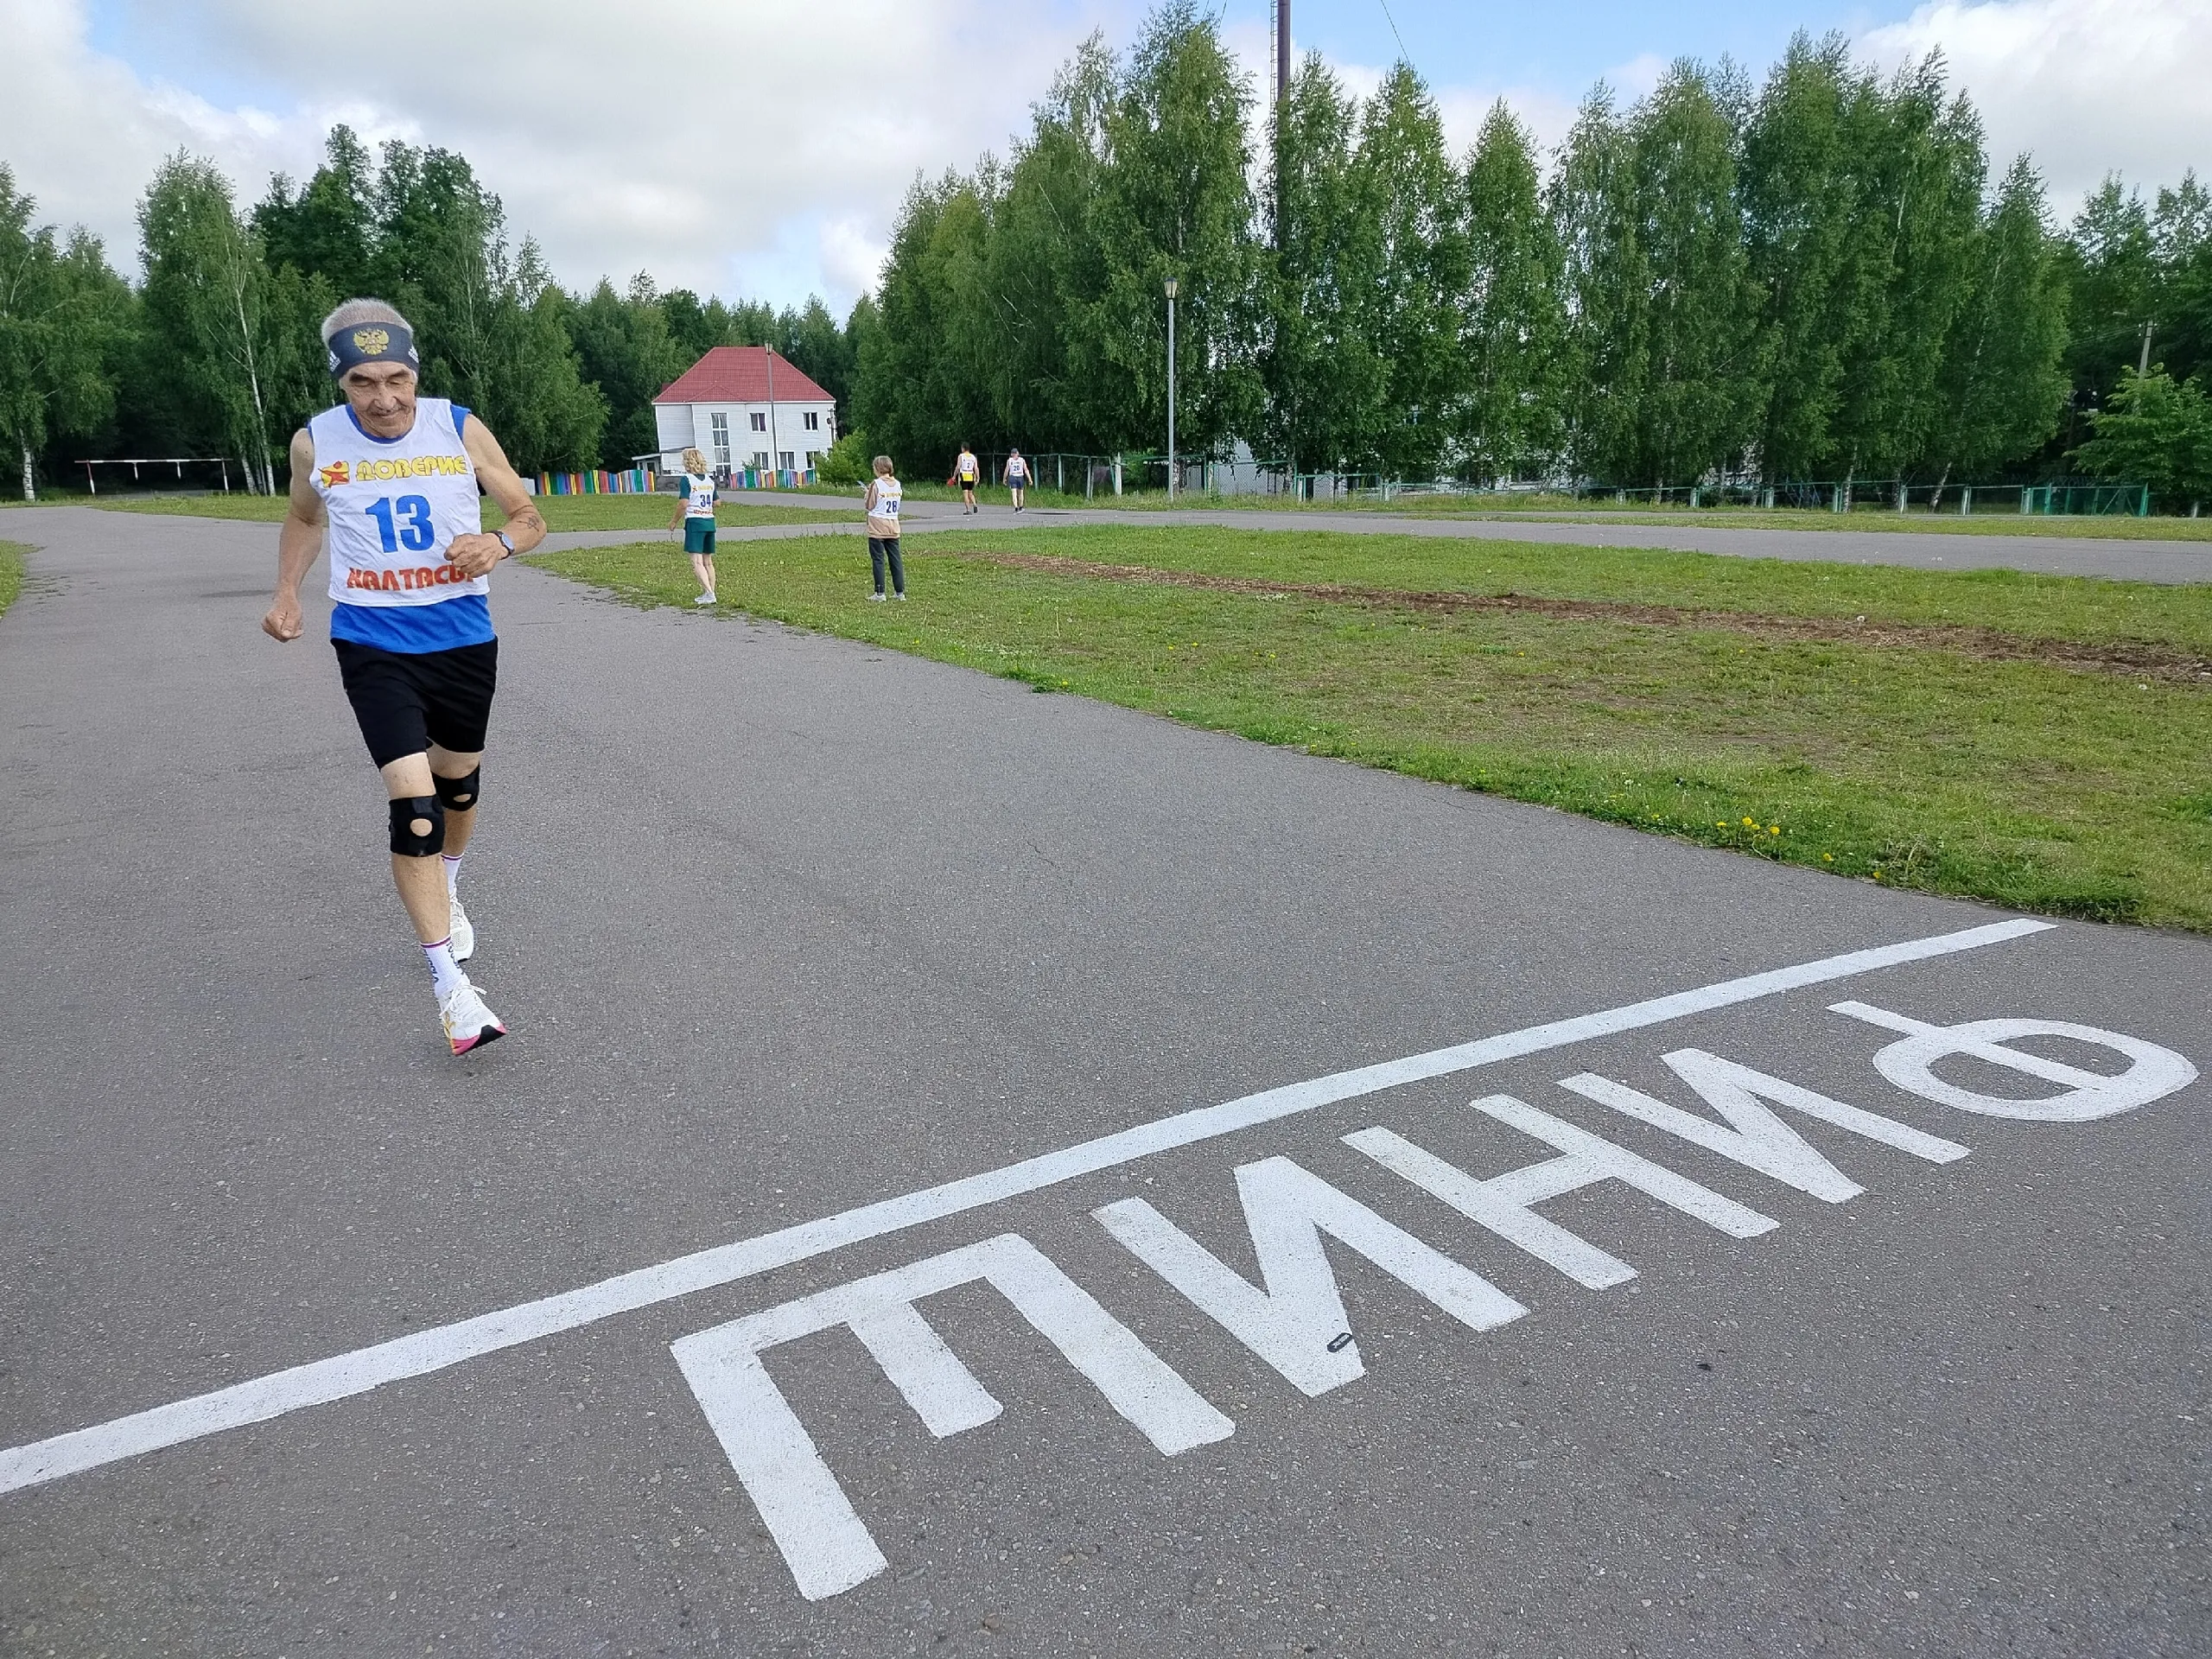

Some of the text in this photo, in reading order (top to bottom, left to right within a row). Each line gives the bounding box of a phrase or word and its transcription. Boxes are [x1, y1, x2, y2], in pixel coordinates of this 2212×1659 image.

[356, 454, 468, 482] ДОВЕРИЕ
[700, 493, 711, 507] 34
[886, 500, 898, 514] 28
[365, 494, 435, 554] 13
[670, 1000, 2200, 1601] ФИНИШ
